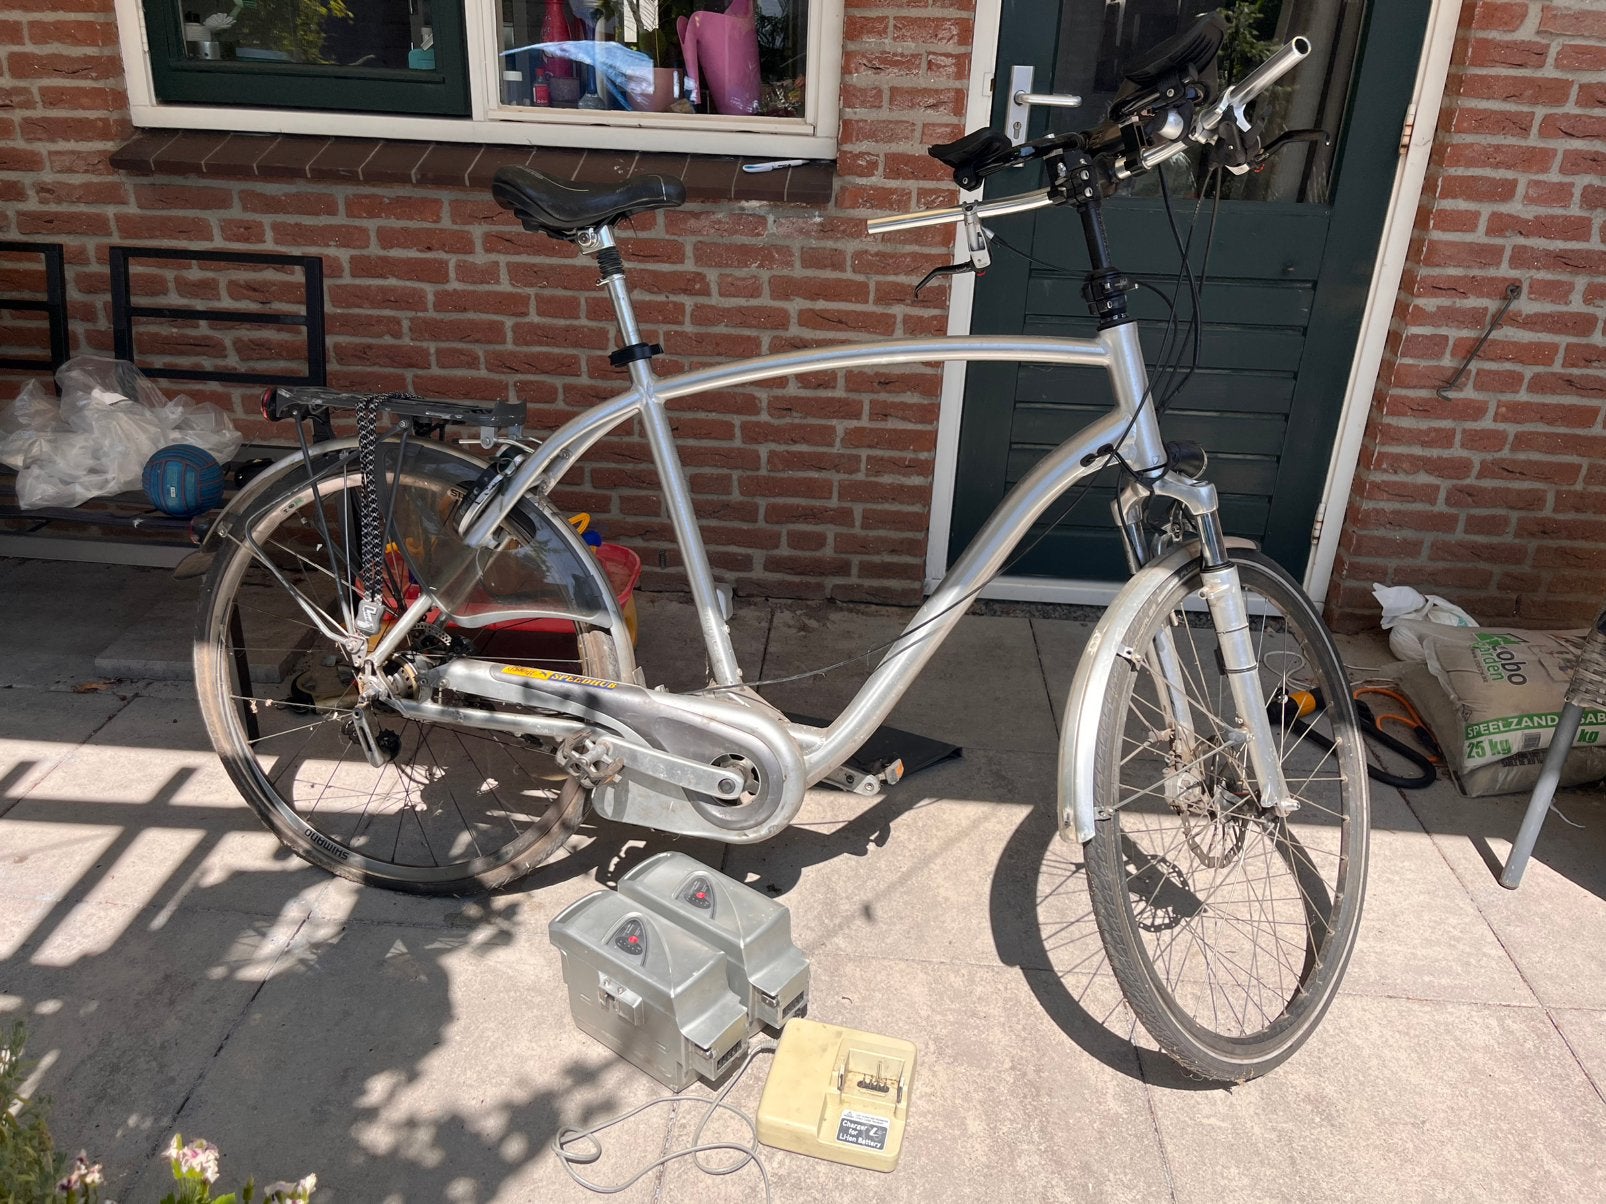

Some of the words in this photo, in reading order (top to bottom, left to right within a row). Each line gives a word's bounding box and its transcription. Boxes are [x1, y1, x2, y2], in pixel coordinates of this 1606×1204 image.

[1467, 716, 1558, 738] SPEELZAND
[1466, 741, 1487, 759] 25
[1488, 739, 1511, 756] kg
[304, 828, 350, 860] SHIMANO
[842, 1120, 867, 1131] Charger
[858, 1137, 881, 1148] Battery
